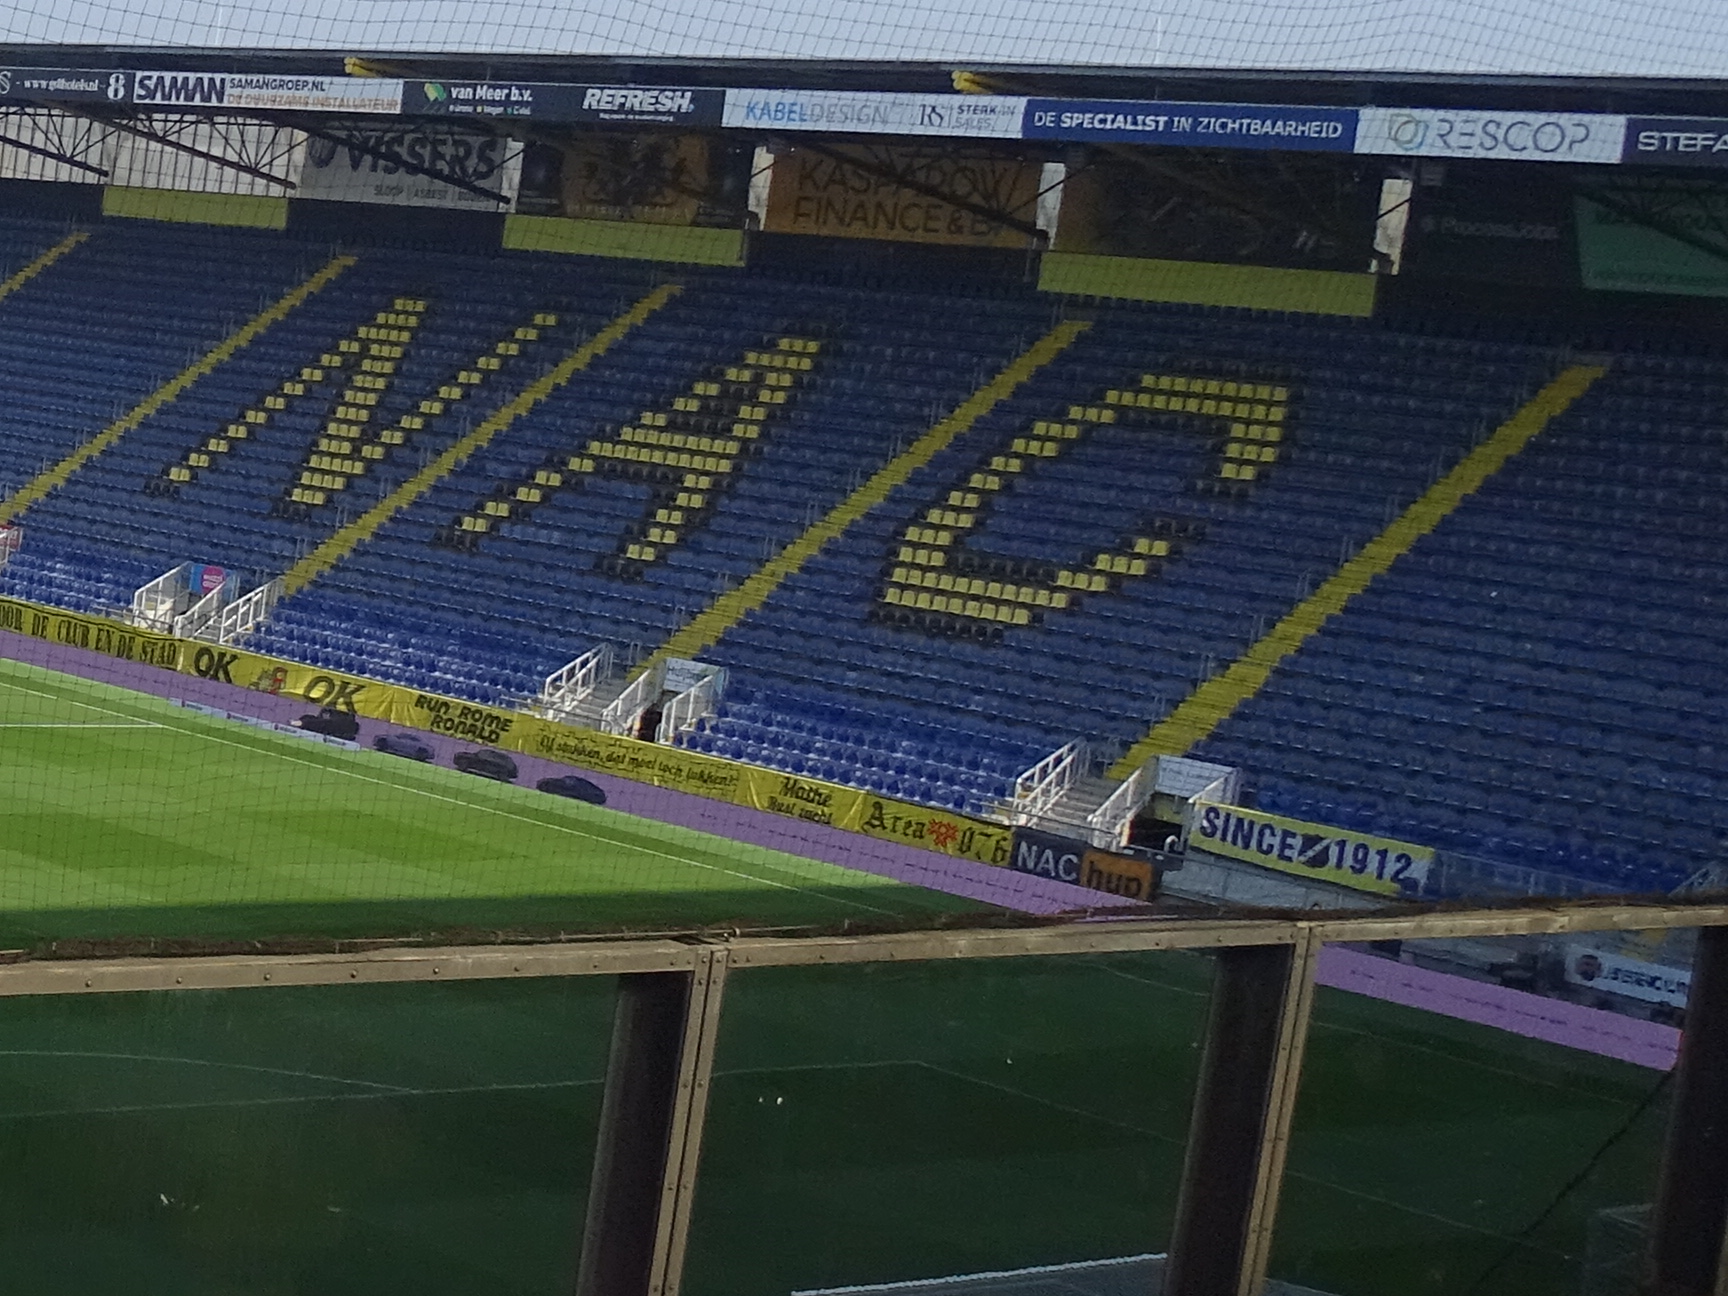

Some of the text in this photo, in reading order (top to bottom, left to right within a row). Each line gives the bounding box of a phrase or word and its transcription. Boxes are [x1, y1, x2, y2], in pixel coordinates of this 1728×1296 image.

[134, 73, 227, 104] SAMAN
[229, 76, 326, 93] SAMANGROEP.NL
[310, 95, 400, 113] INSTALLATEUR
[450, 85, 533, 102] van Meer b.v.
[1033, 110, 1343, 138] DE SPECIALIST IN ZICHTBAARHEID
[344, 134, 498, 180] VISSERS
[793, 196, 942, 234] FINANCE
[32, 610, 49, 638] DE
[57, 617, 90, 649] CLUB
[96, 626, 116, 655] EN
[117, 634, 138, 662] DE
[142, 639, 177, 667] STAD
[193, 645, 241, 685] OK
[301, 674, 369, 716] OK
[459, 704, 513, 734] ROME
[861, 799, 927, 842] Area
[1016, 838, 1079, 882] NAC
[1199, 805, 1415, 894] SINCE 1912
